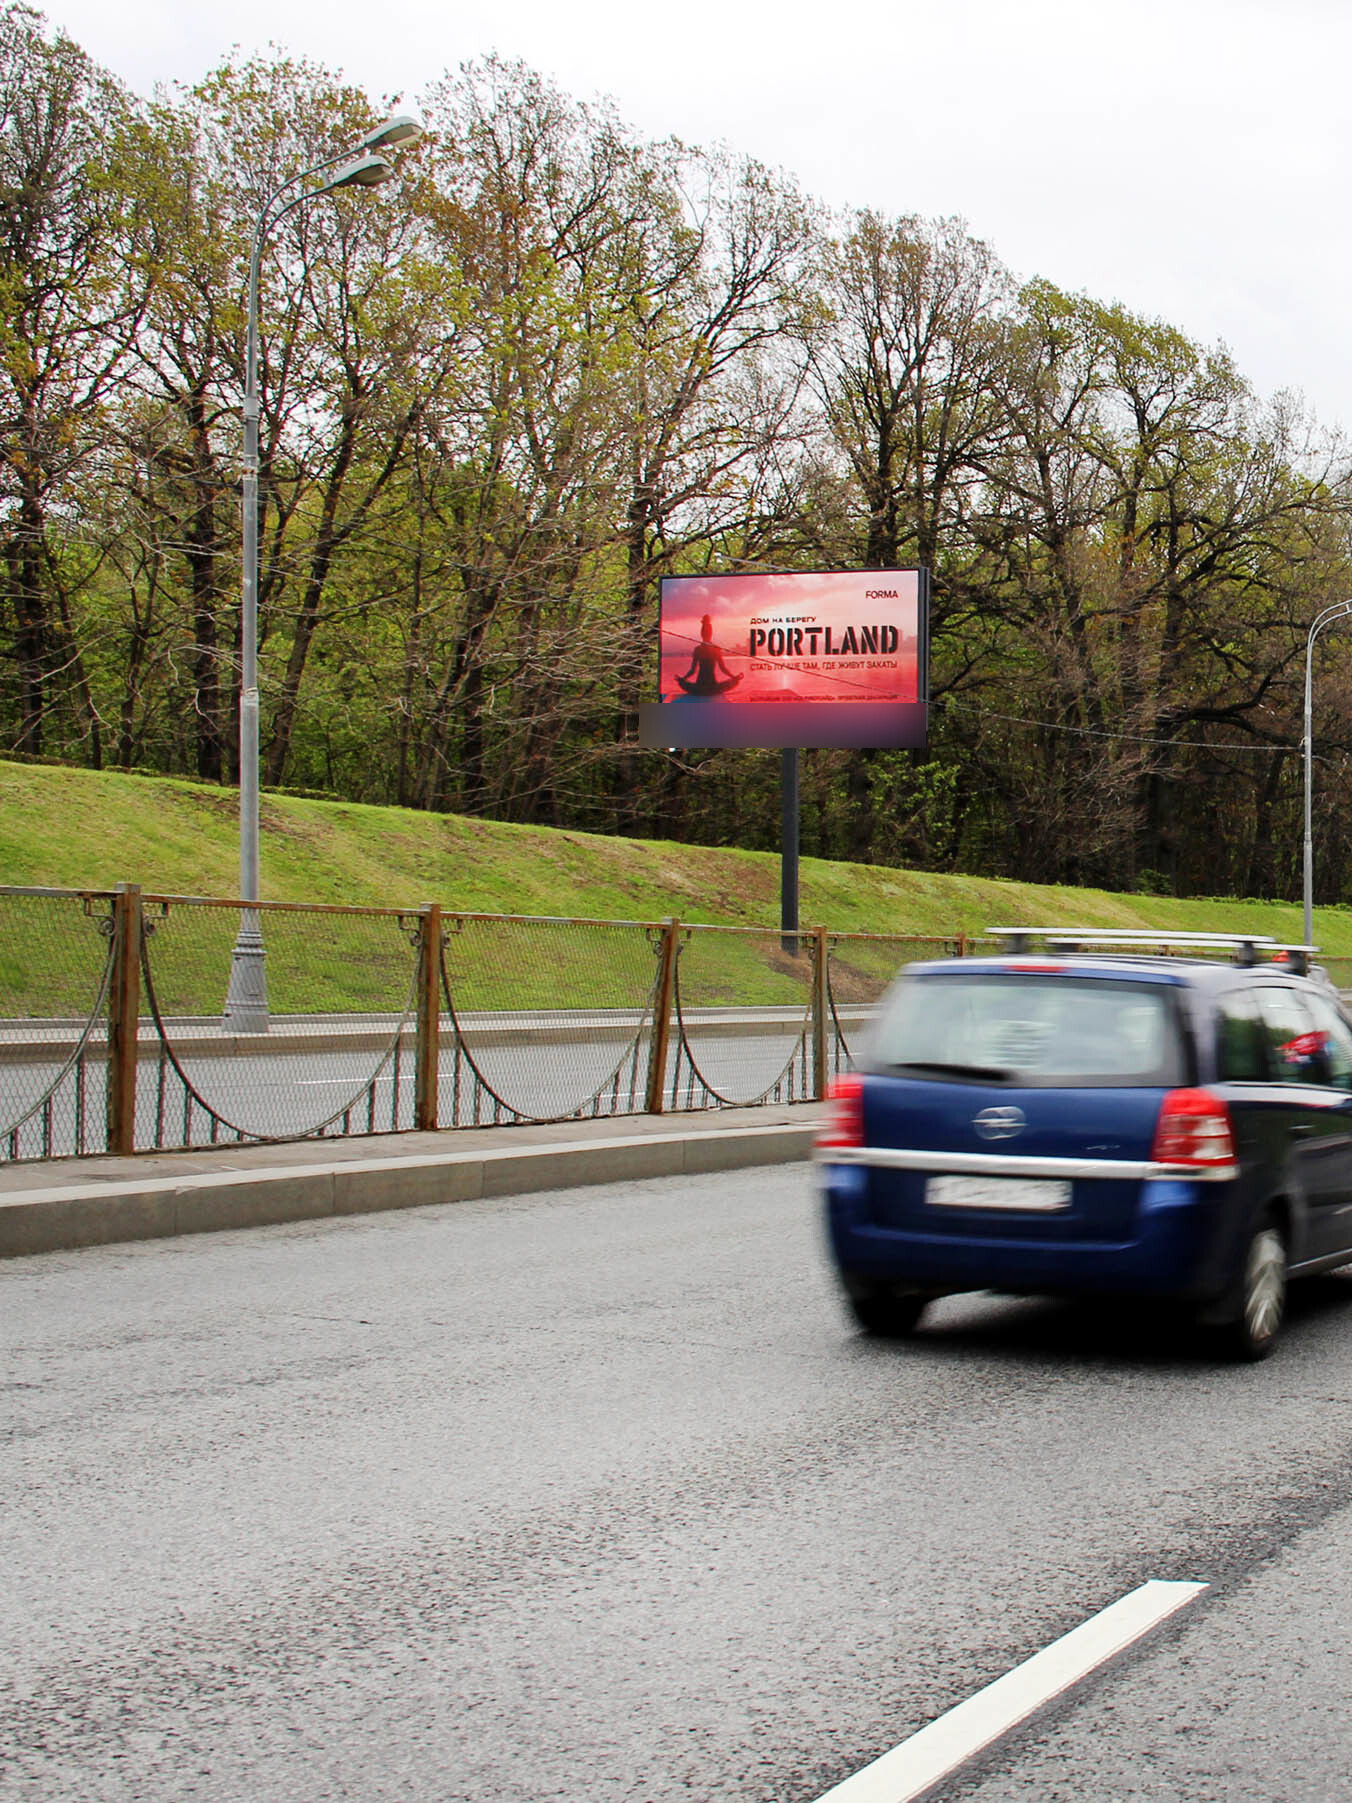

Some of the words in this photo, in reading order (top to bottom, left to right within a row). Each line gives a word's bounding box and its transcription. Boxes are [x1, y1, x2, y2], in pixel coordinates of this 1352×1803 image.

[865, 590, 898, 599] FORMA
[750, 625, 899, 656] PORTLAND
[750, 662, 772, 671] СТАТЬ
[822, 661, 836, 670] ГДЕ
[838, 661, 865, 669] ЖИВУТ
[867, 660, 898, 669] ЗАКАТЫ
